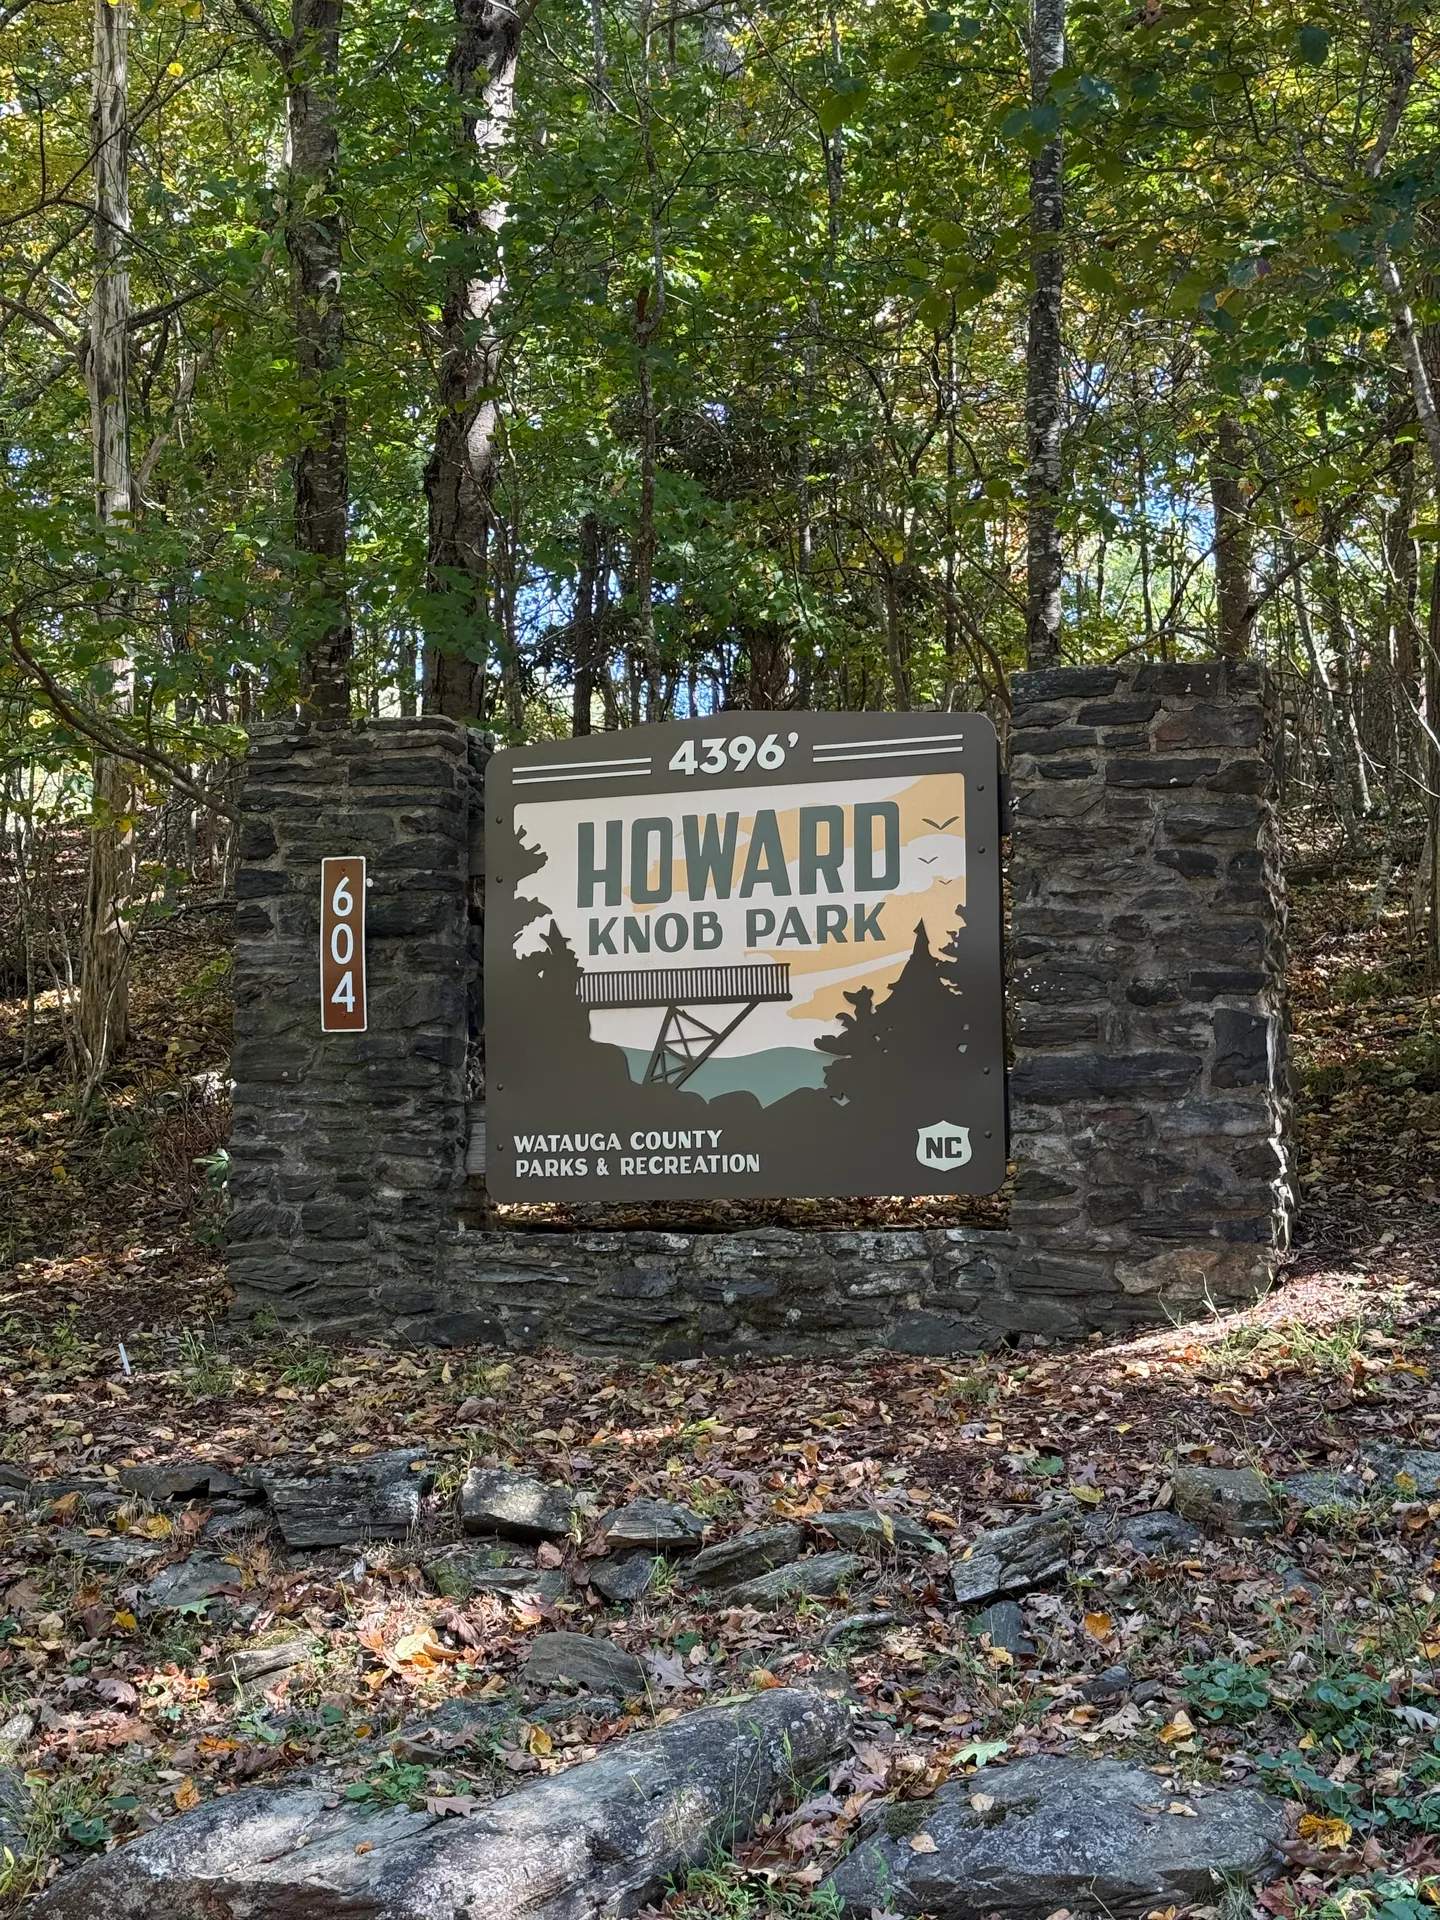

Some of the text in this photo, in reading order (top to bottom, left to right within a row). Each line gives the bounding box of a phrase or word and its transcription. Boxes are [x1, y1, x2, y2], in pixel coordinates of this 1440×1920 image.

[577, 801, 900, 908] HOWARD
[331, 876, 356, 1013] 604
[588, 902, 886, 956] KNOB PARK
[513, 1129, 723, 1154] WATAUGA COUNTY
[925, 1136, 963, 1160] NC
[515, 1154, 760, 1178] PARKS & RECREATION
